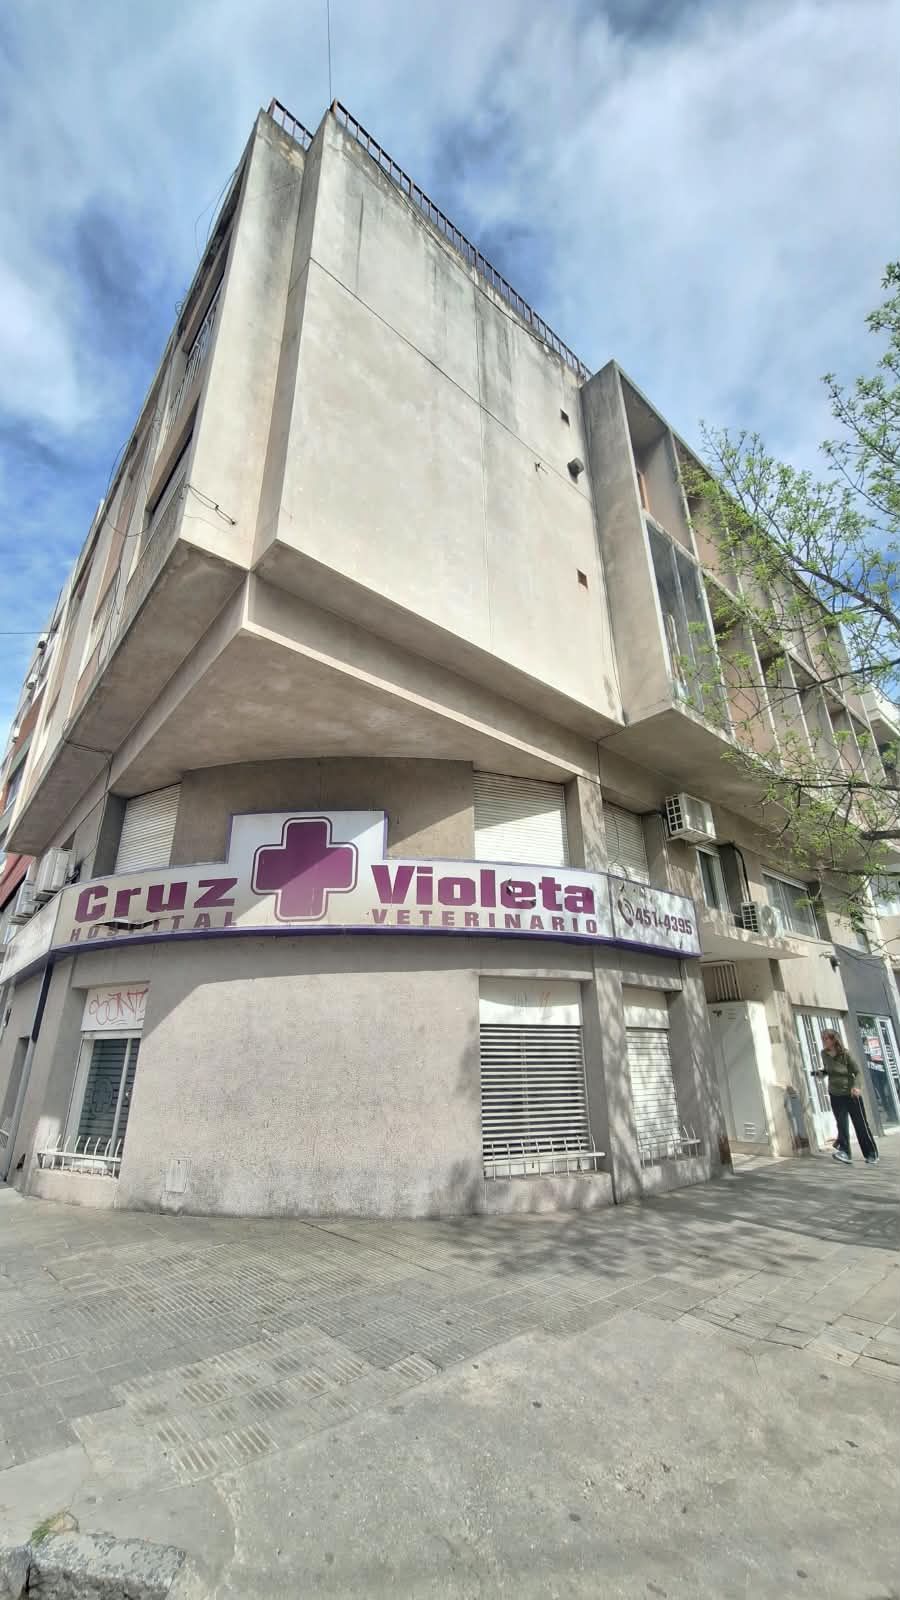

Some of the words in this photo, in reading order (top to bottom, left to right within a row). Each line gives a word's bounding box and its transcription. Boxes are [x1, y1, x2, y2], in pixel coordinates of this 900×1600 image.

[74, 877, 239, 923] Cruz
[371, 864, 597, 915] Violeta
[69, 911, 237, 942] HOSITAL
[371, 908, 598, 934] VETERINARIO
